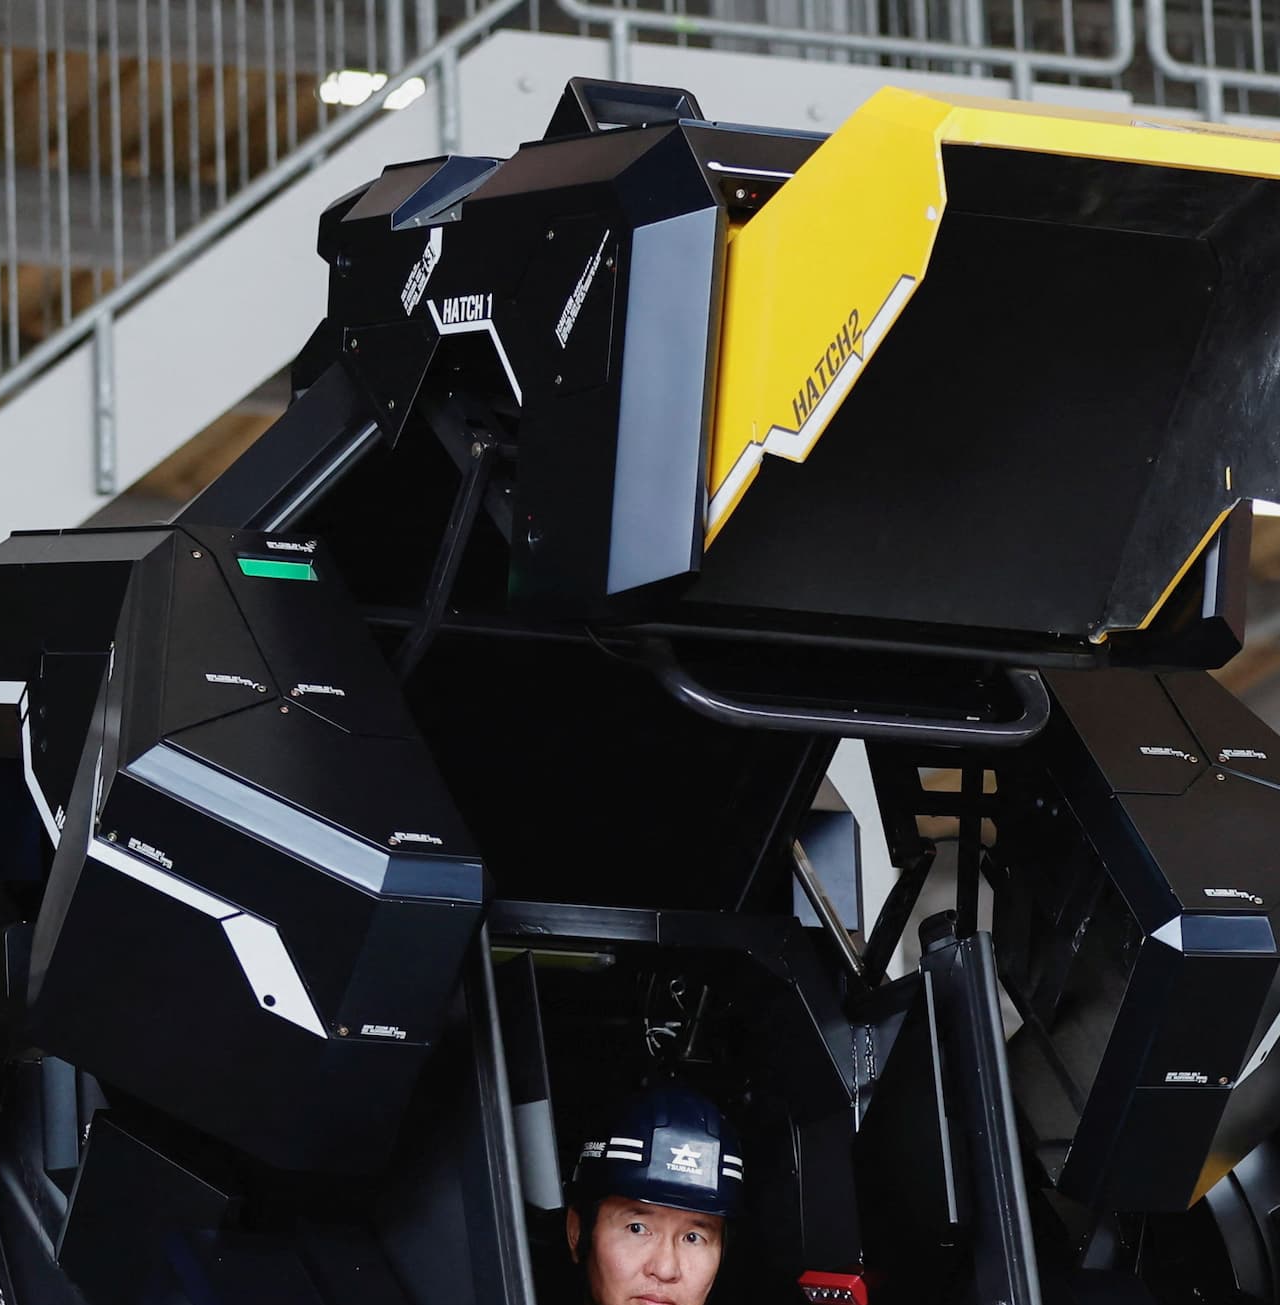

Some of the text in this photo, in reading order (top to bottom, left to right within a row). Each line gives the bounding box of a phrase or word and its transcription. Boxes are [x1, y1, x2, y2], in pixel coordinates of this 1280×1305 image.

[442, 293, 493, 324] HATCH 1
[792, 308, 863, 427] HATCH2
[666, 1162, 703, 1175] TSUBAME
